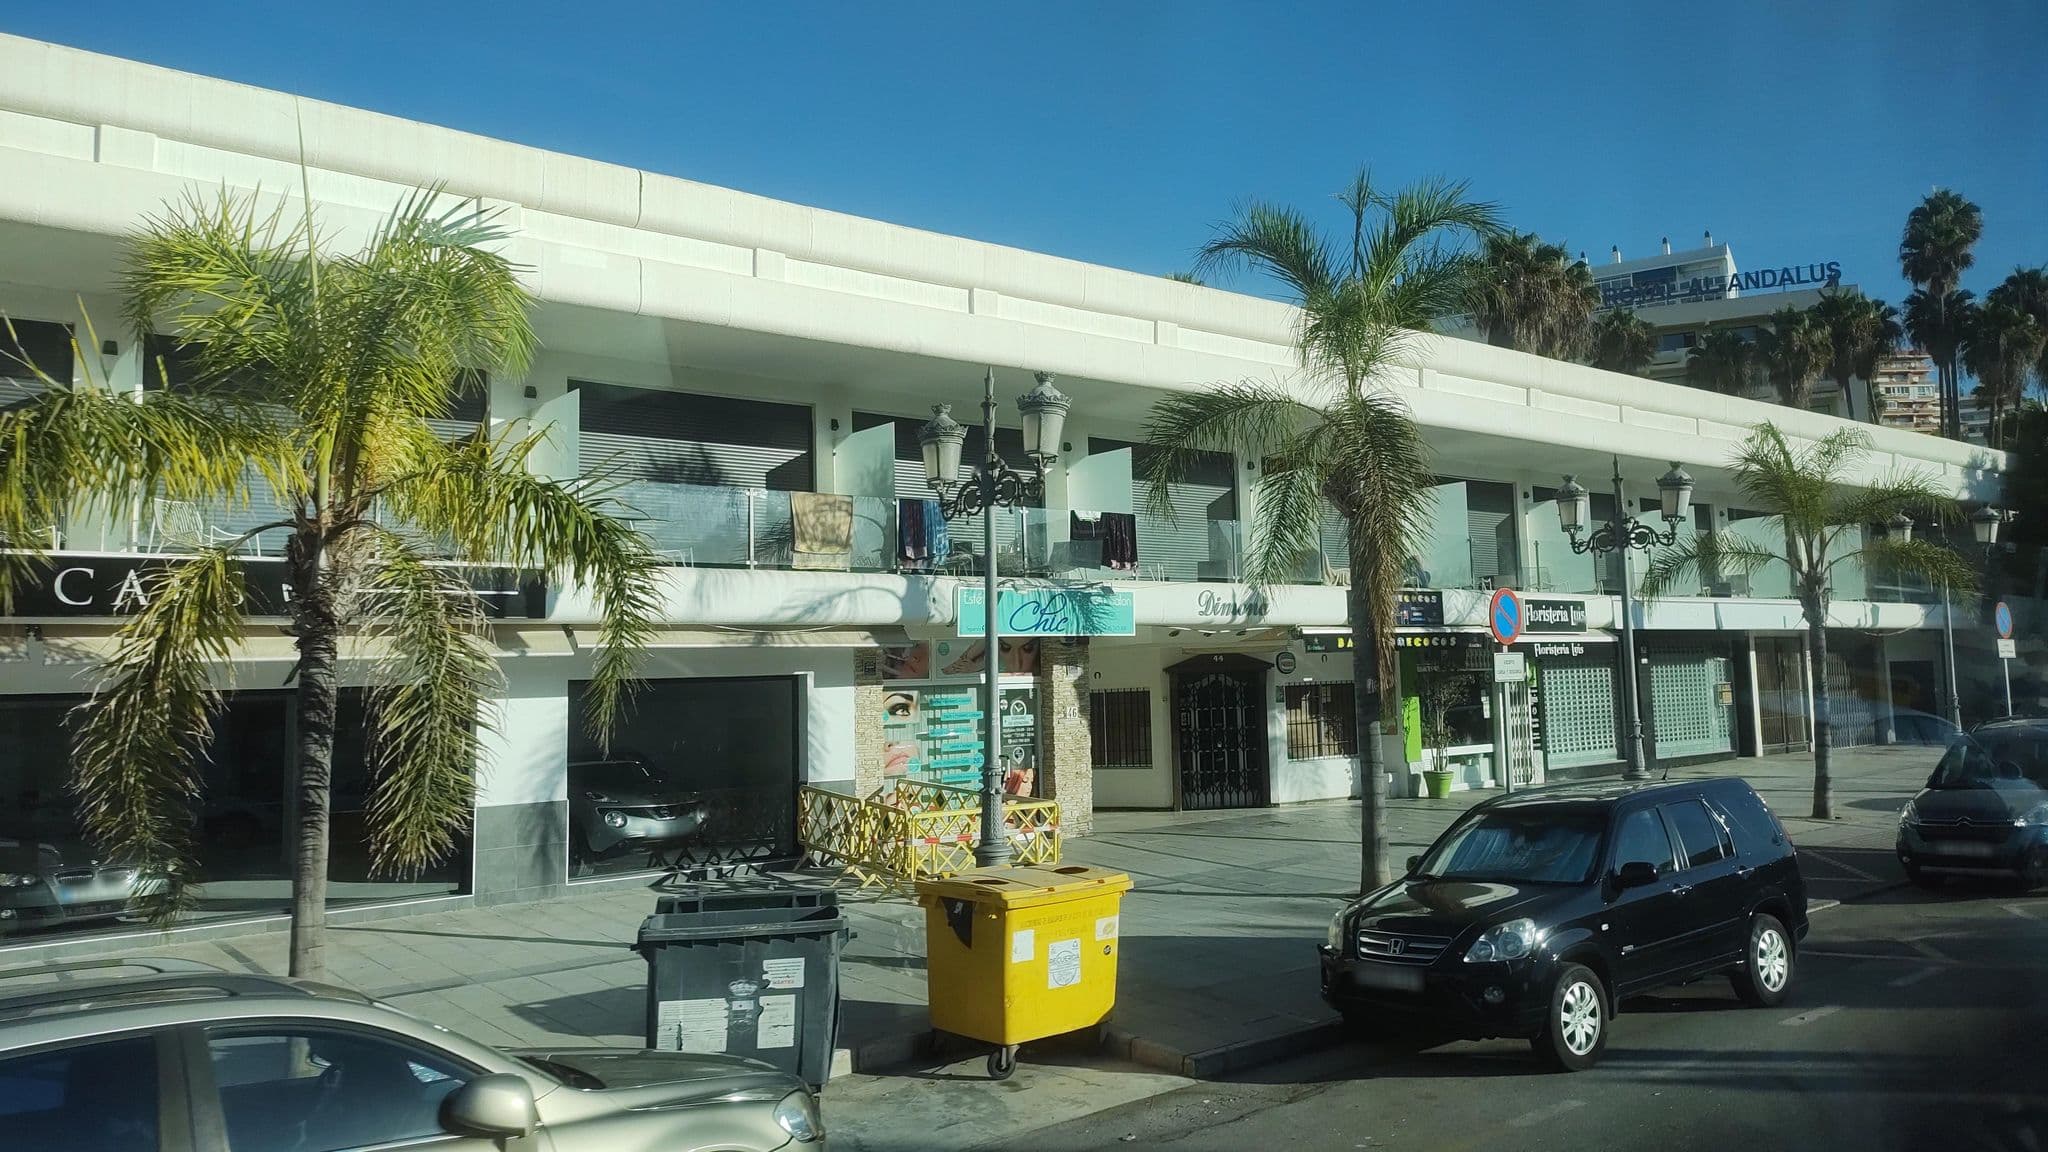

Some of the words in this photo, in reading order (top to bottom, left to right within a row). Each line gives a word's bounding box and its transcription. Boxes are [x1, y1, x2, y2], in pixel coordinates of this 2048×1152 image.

[1728, 261, 1841, 292] ANDALUS
[1009, 592, 1070, 633] Chic
[1525, 604, 1569, 626] Floristeria
[1570, 605, 1585, 626] Luis
[1534, 643, 1569, 657] Floristeria
[1066, 706, 1078, 719] 46
